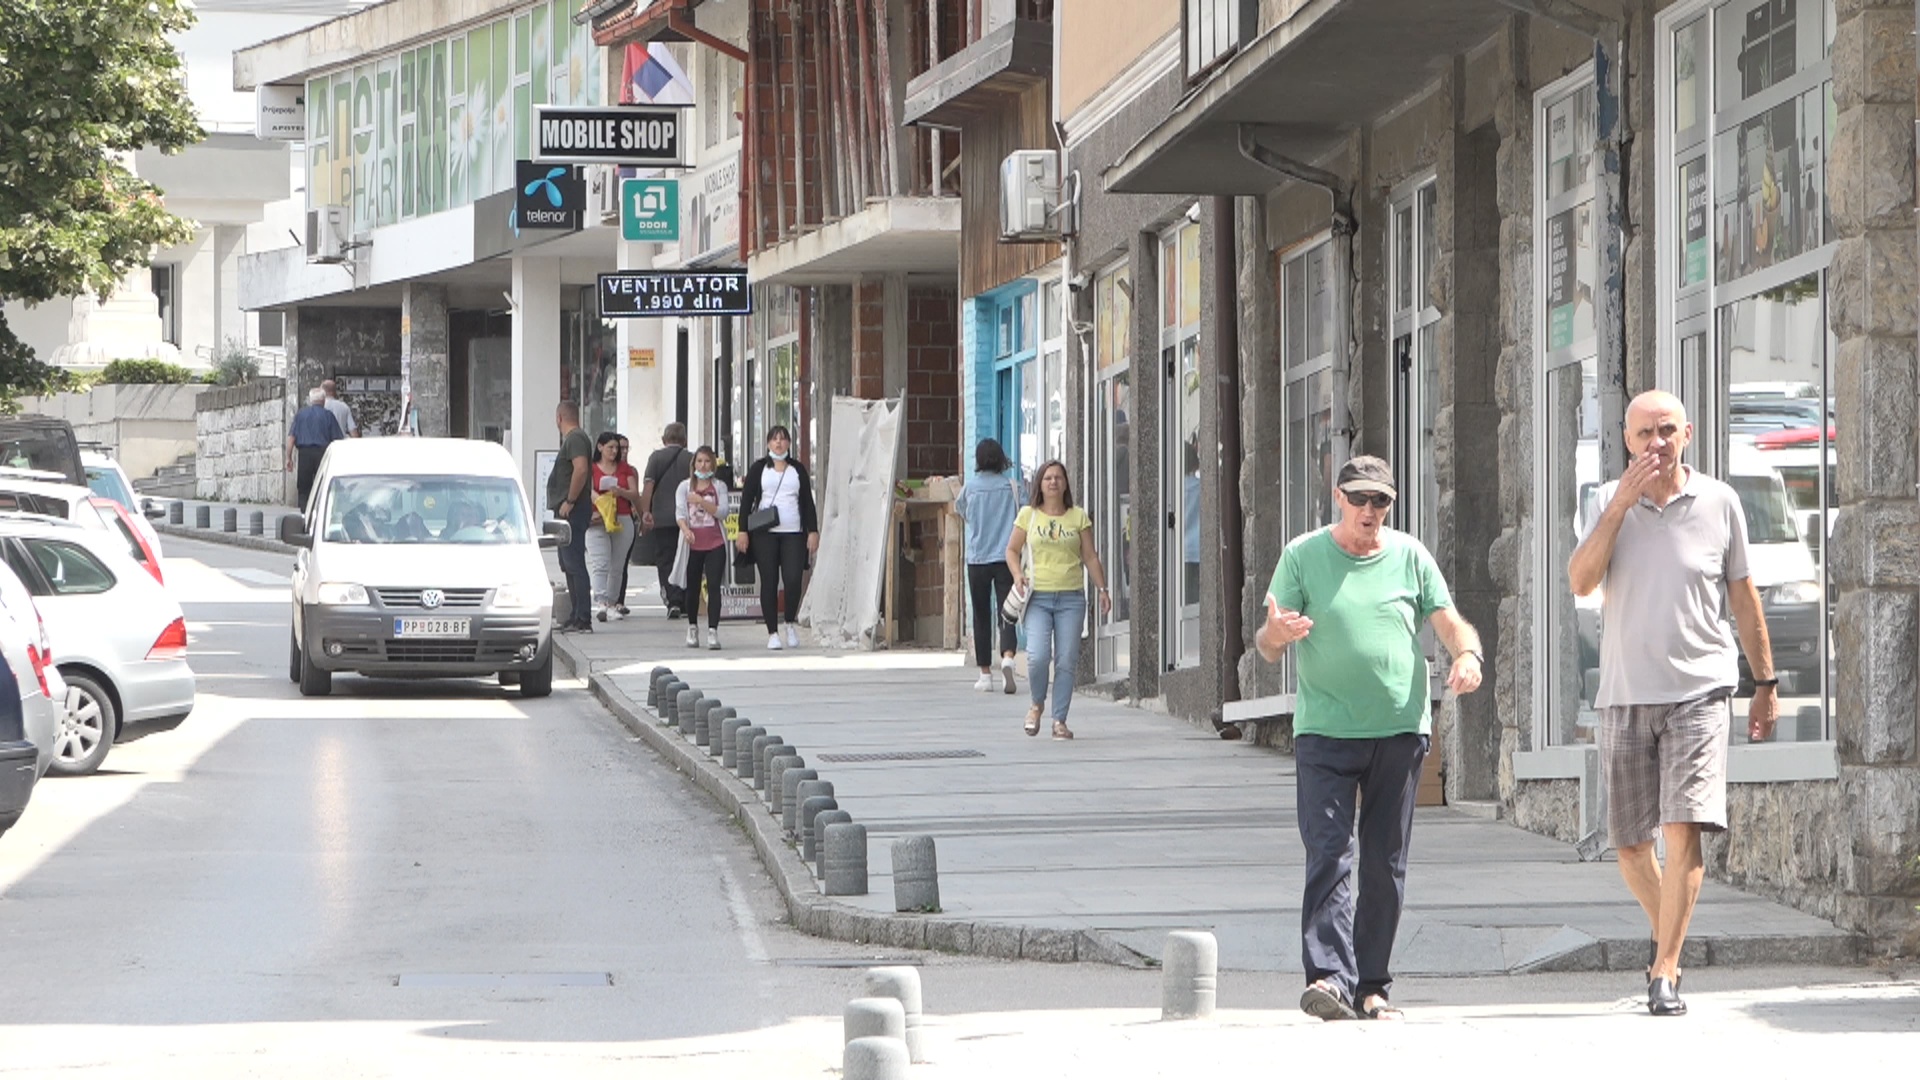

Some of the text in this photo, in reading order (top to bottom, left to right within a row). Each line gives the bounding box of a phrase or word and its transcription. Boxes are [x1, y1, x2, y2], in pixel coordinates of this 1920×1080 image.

[541, 119, 675, 150] MOBILE SHOP
[526, 209, 568, 223] telenor
[639, 221, 668, 229] DDOR
[607, 276, 739, 295] VENTILATOR
[632, 293, 723, 310] 1.990 din
[403, 621, 418, 633] PP
